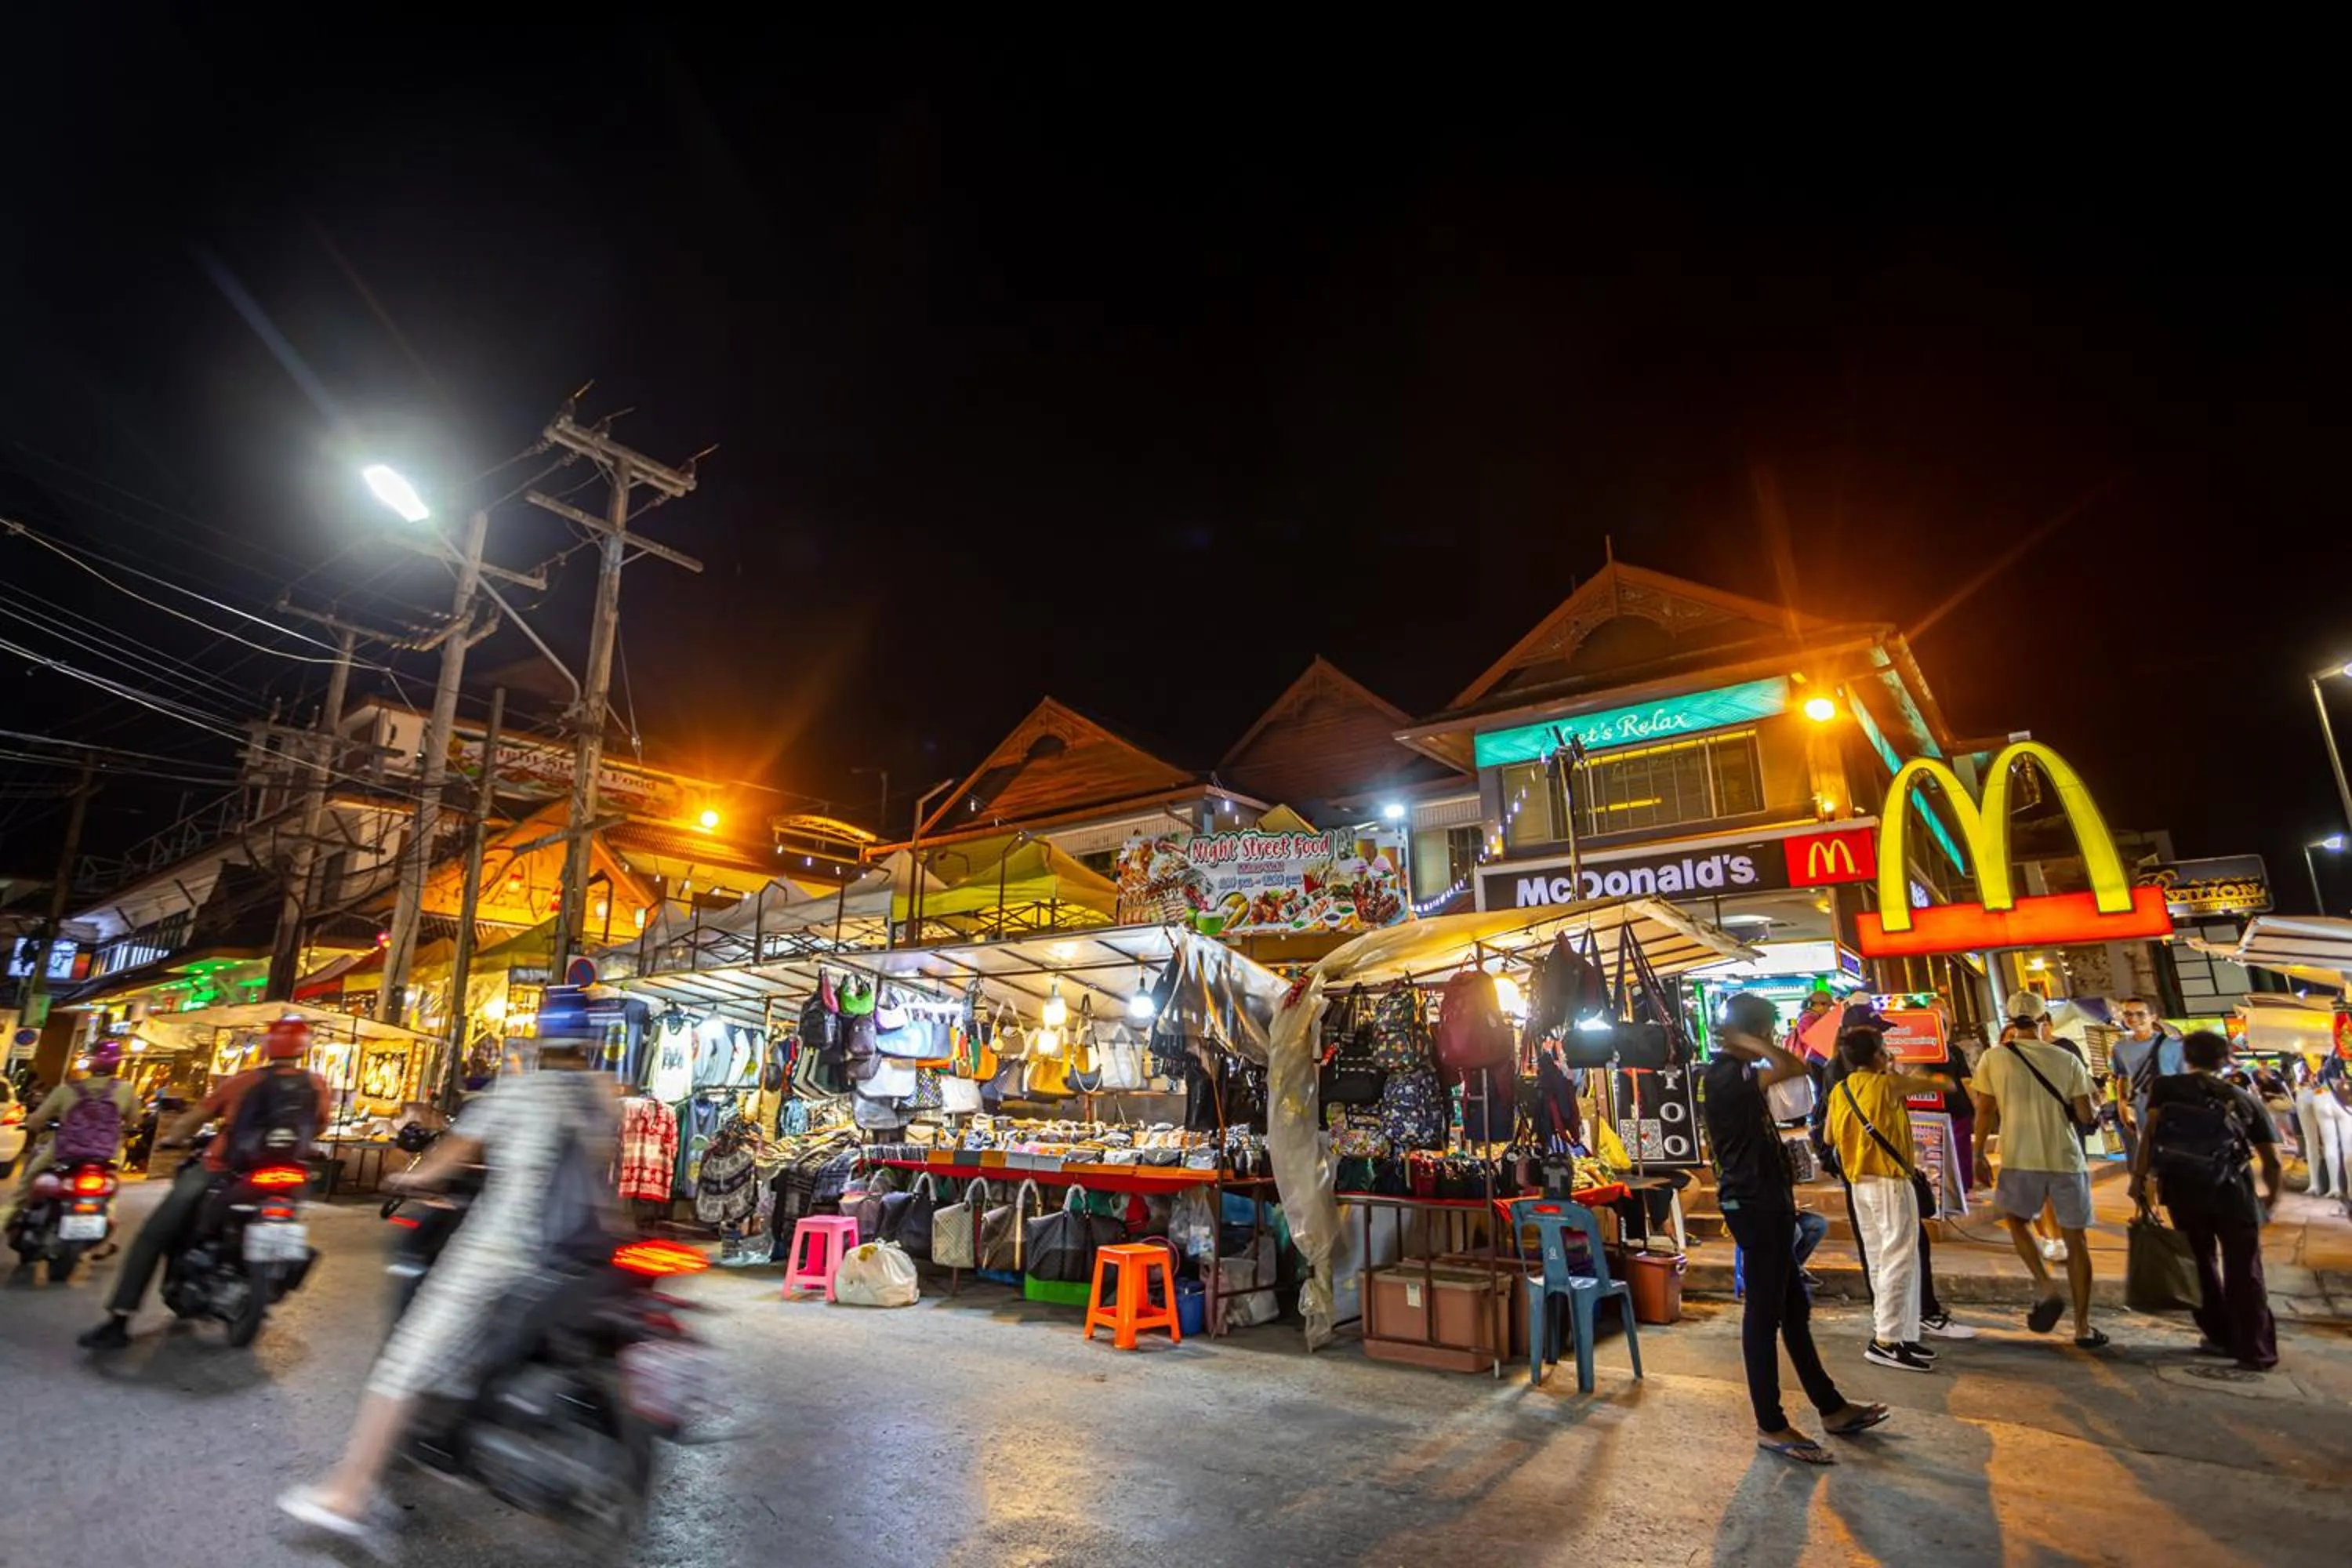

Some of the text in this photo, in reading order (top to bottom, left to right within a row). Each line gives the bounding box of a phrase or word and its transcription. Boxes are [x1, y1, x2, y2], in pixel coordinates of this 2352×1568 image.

[1616, 708, 1688, 737] Relax
[1193, 834, 1330, 863] Night Street Food
[1516, 855, 1756, 906] McDonald's
